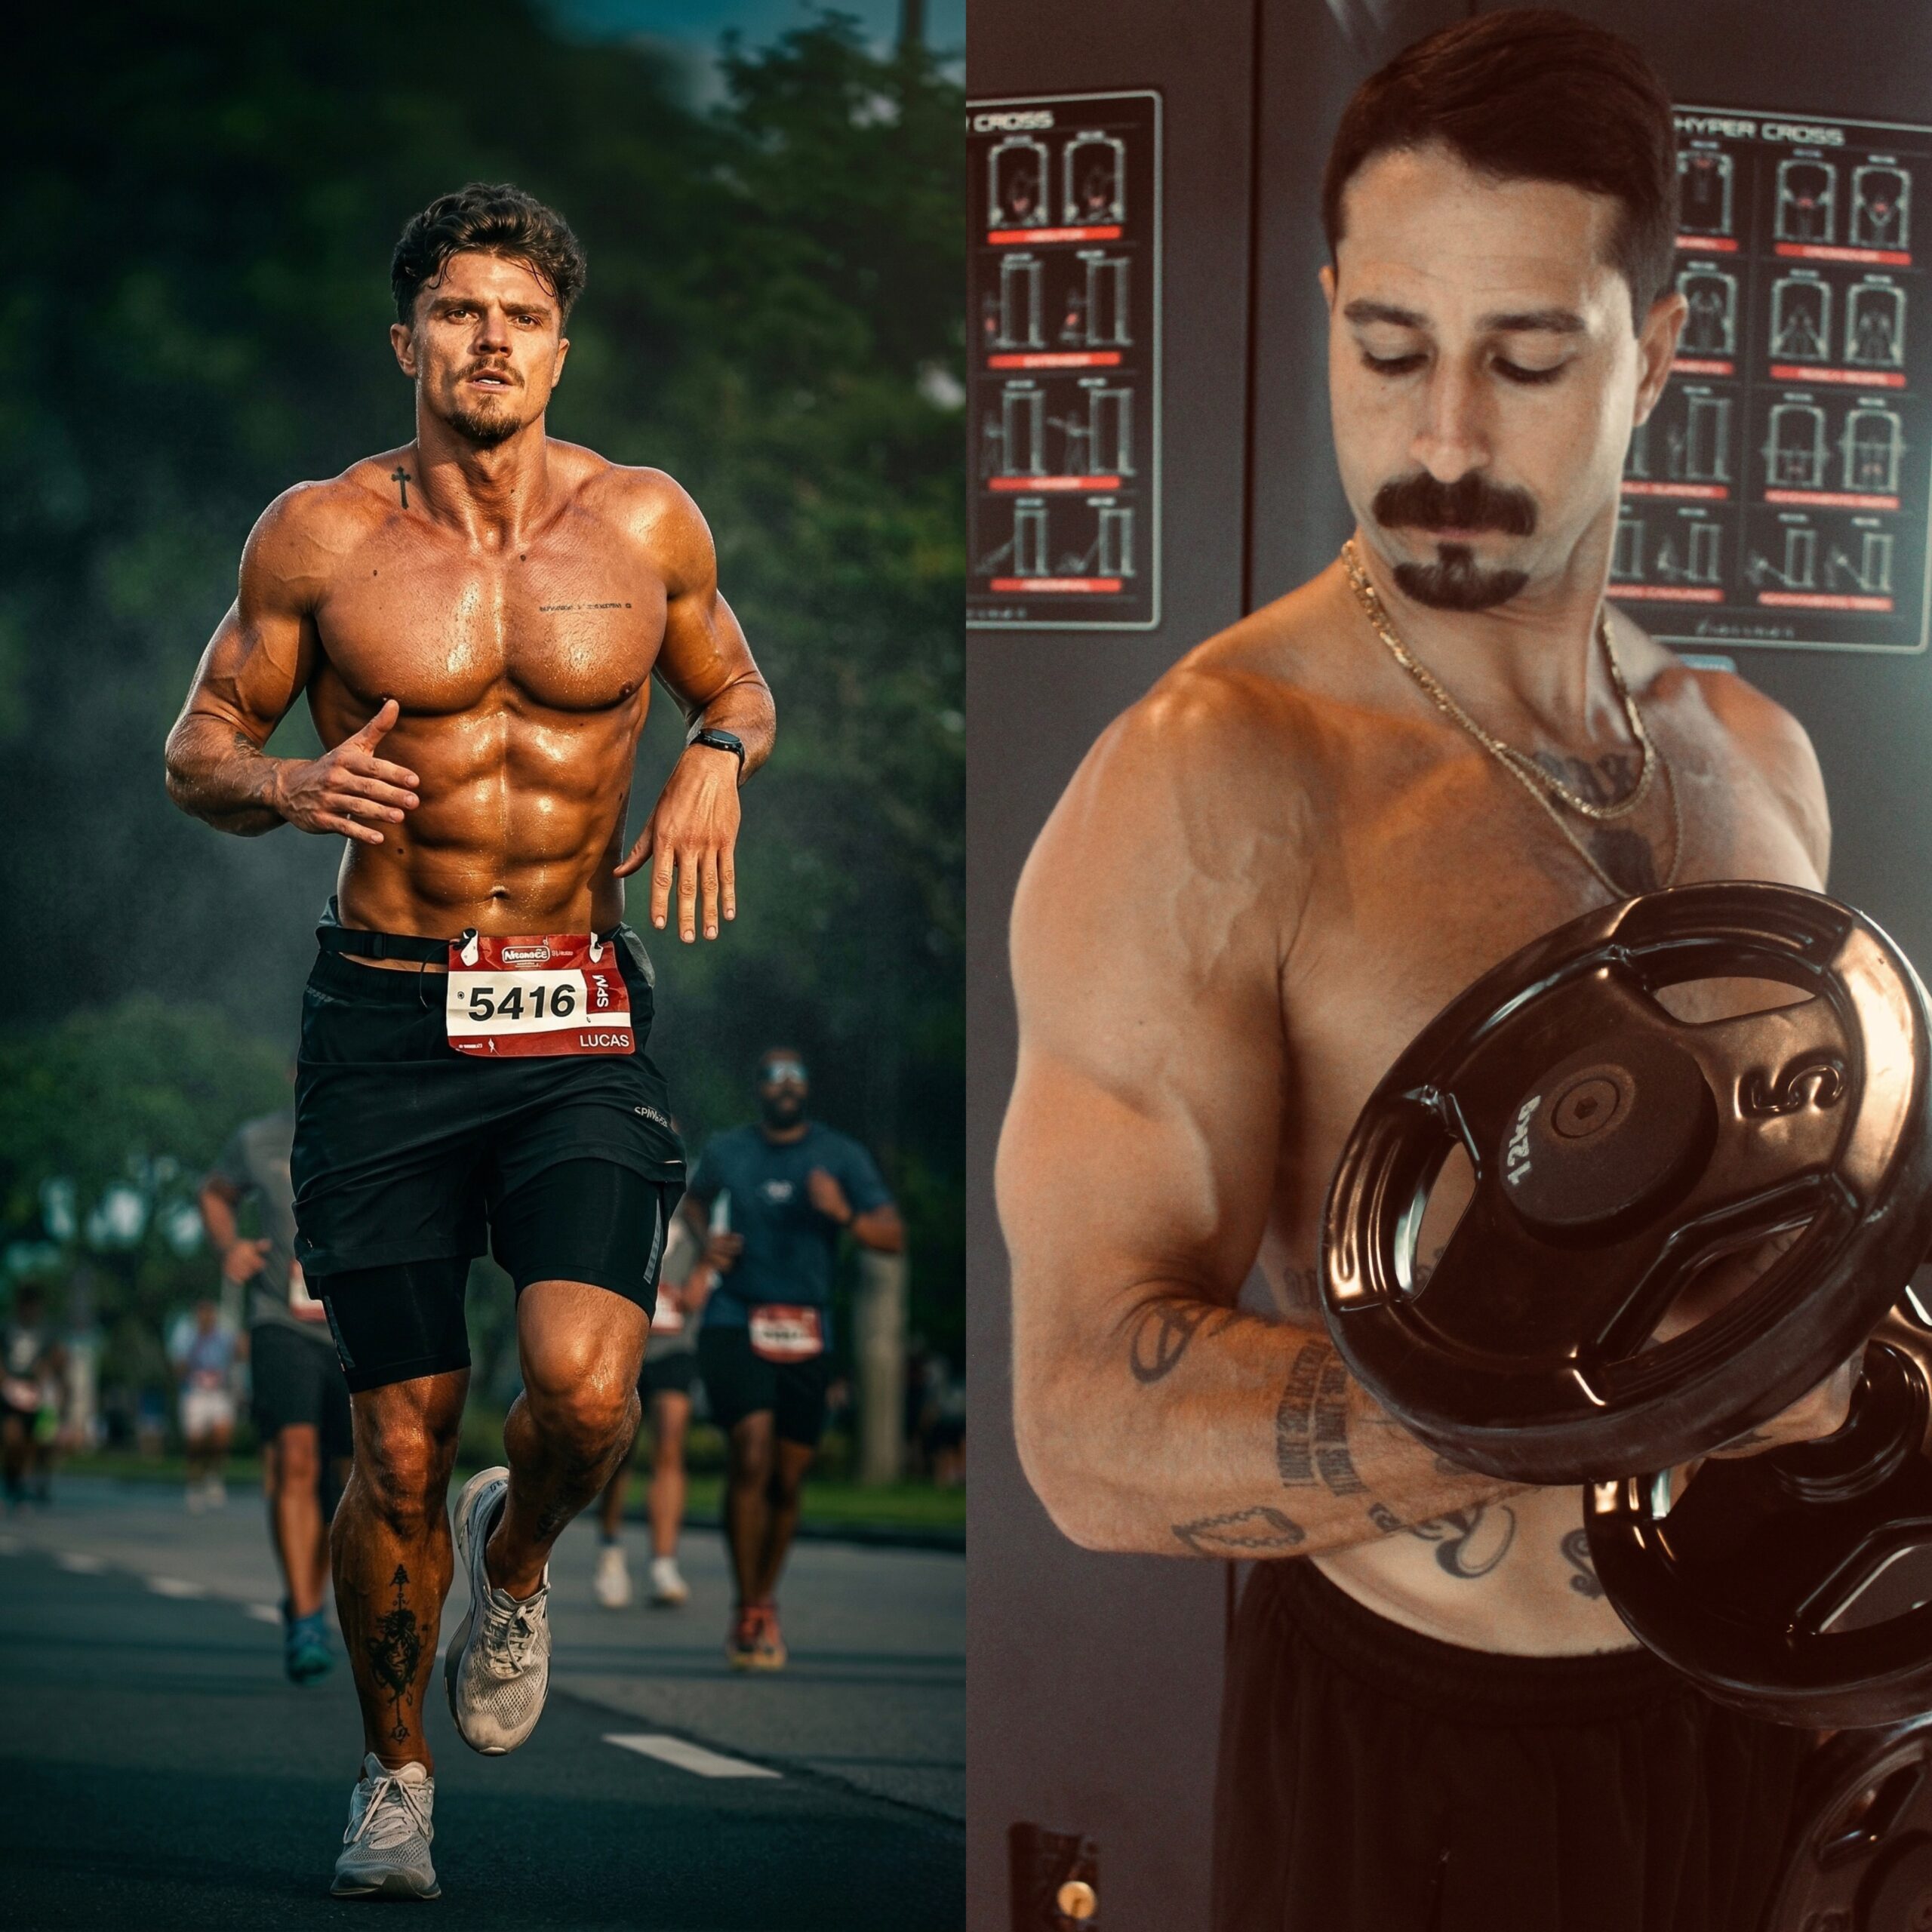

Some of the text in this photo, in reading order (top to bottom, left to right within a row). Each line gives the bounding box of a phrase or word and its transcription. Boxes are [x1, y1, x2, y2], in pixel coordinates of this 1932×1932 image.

[1761, 122, 1844, 146] CROSS
[468, 984, 576, 1021] 5416
[592, 974, 609, 1008] SPM
[580, 1034, 629, 1047] LUCAS
